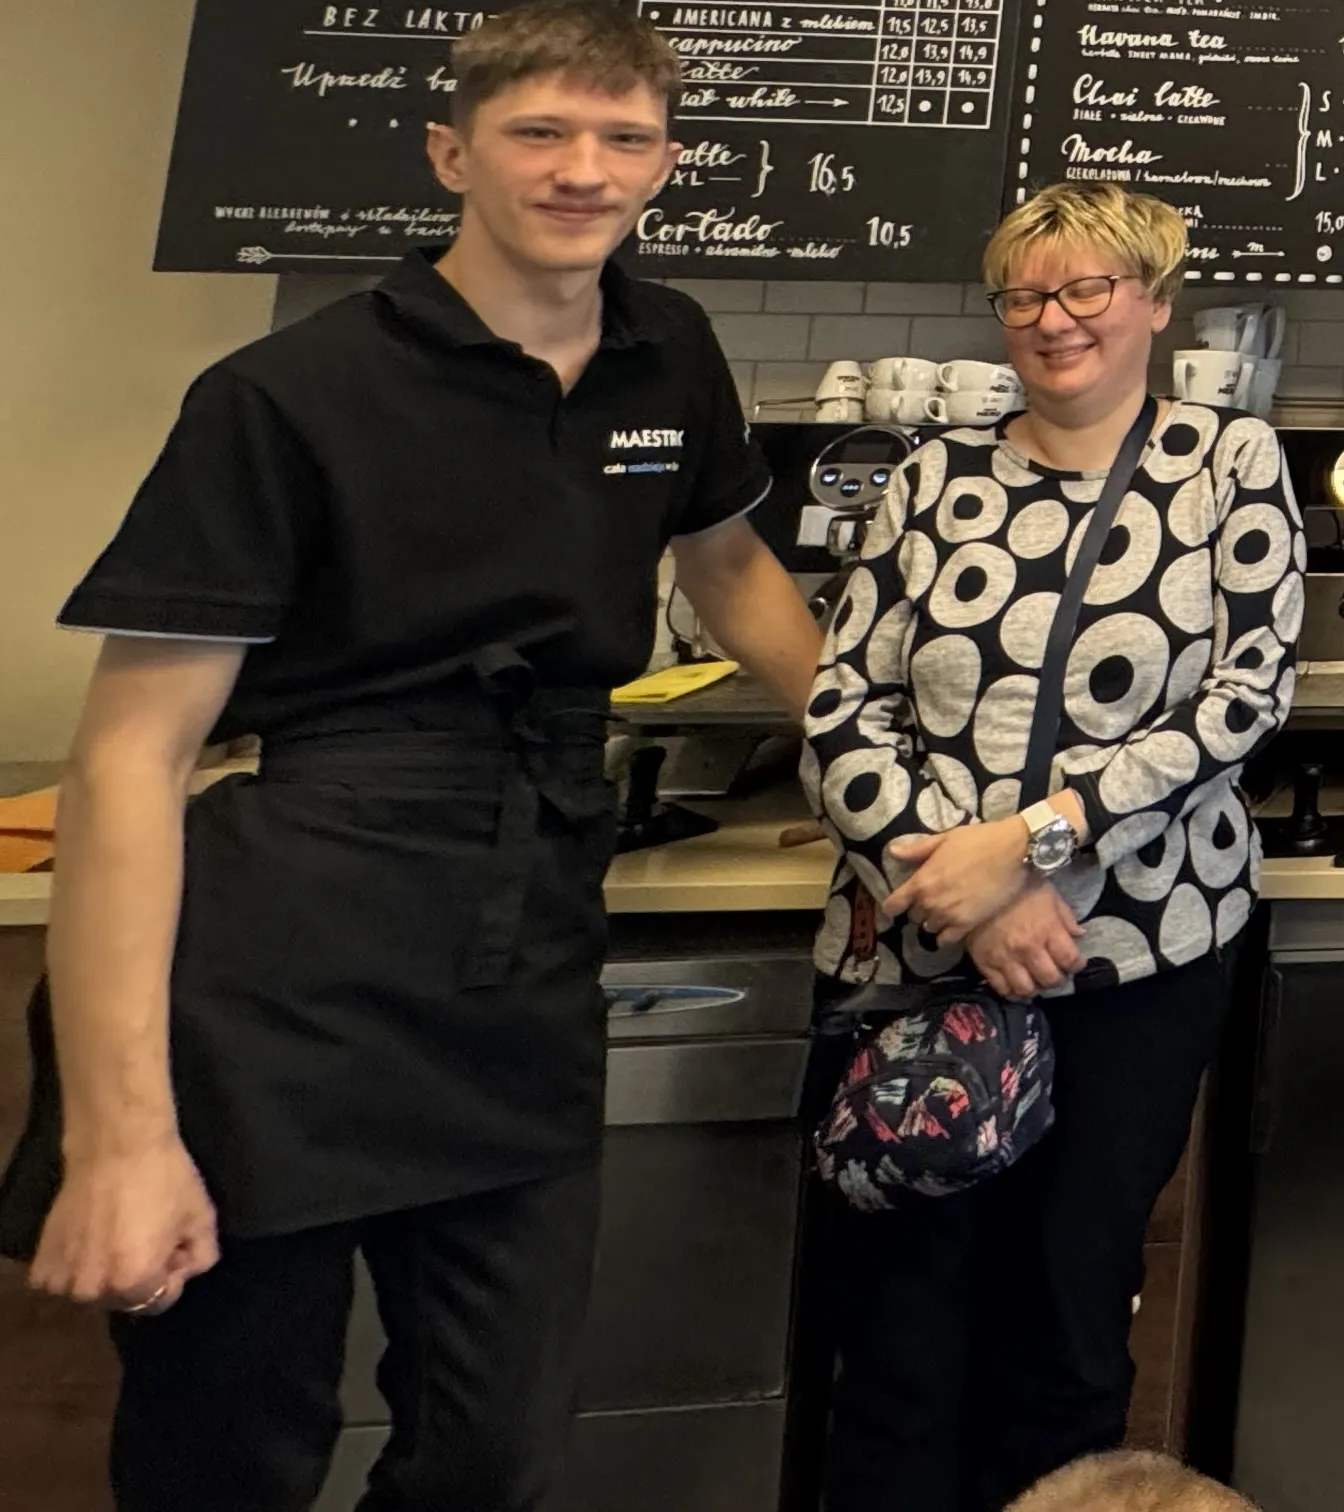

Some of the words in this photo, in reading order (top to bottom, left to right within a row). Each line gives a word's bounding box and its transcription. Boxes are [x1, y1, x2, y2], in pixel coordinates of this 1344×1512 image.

[322, 5, 379, 28] BEZ
[405, 8, 499, 32] LAKTO
[672, 8, 773, 28] AMERICANA
[800, 15, 876, 32] mlekiem
[1187, 29, 1228, 50] tea
[726, 87, 801, 109] white
[1072, 73, 1140, 107] Chai
[1318, 90, 1332, 113] S
[1060, 133, 1164, 164] Mocha
[1316, 129, 1333, 148] M
[678, 141, 747, 166] atte
[670, 170, 705, 186] XL
[1315, 162, 1327, 182] L
[637, 206, 785, 242] Cortado
[866, 216, 913, 249] 10,5
[638, 243, 689, 256] ESPRESSO
